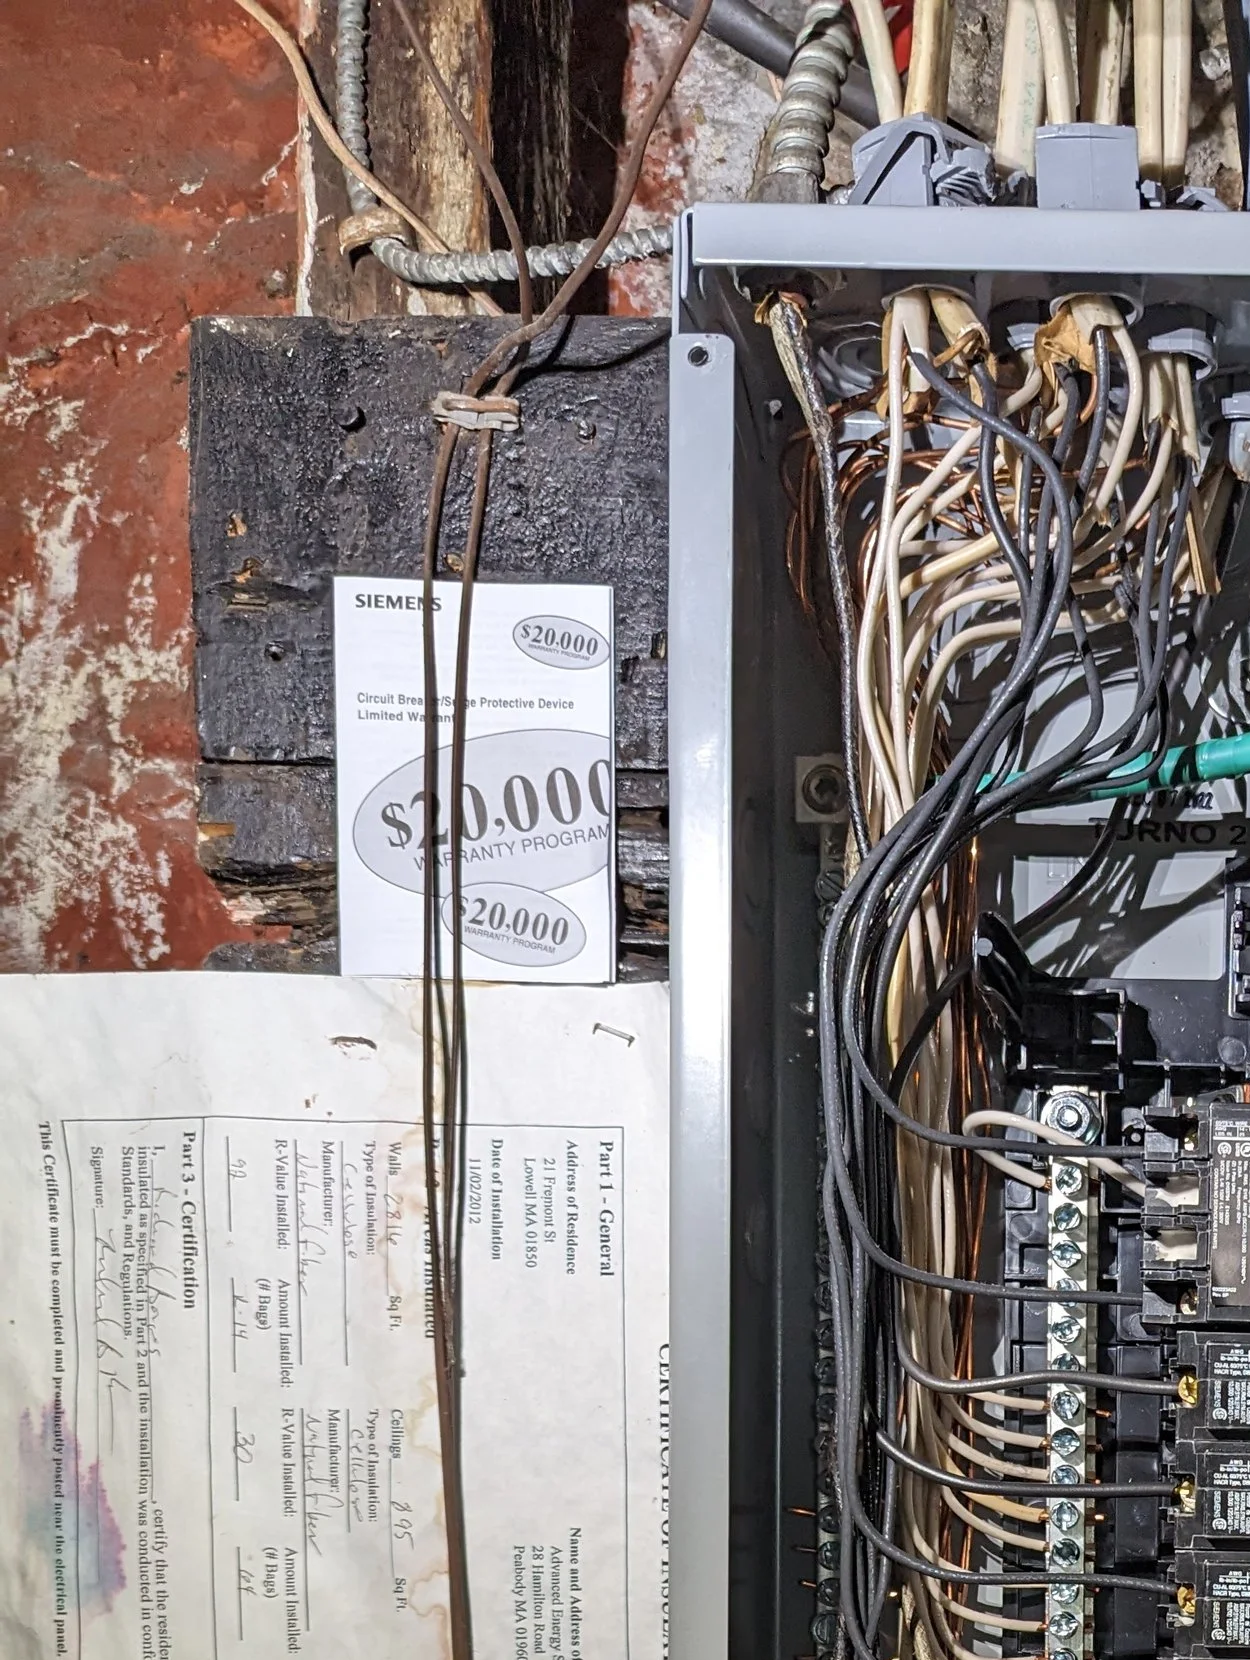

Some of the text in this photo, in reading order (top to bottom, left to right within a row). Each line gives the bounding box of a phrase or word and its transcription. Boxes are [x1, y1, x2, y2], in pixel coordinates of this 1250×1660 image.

[357, 692, 395, 705] Circuit
[480, 696, 535, 710] Protective
[538, 698, 574, 710] Device
[358, 710, 403, 722] Limited
[1229, 825, 1247, 846] 2
[464, 925, 557, 955] WARRANTY PROGRAM
[89, 1146, 105, 1210] Signature:
[322, 1140, 335, 1227] Manufacturer:
[388, 1142, 402, 1176] Walls
[275, 1139, 289, 1250] R-Value Installed:
[363, 1140, 377, 1256] Type of Insulation:
[468, 1157, 482, 1224] 11/02/2012
[491, 1138, 504, 1260] Date of Installation
[524, 1157, 538, 1268] Lowell MA 01850
[543, 1157, 556, 1243] 21 Fremont St
[566, 1140, 579, 1275] Address of Residence
[599, 1140, 615, 1277] Part 1 General
[119, 1146, 136, 1341] Standards, and Regulations.
[181, 1131, 198, 1310] Part 3 Certification
[134, 1231, 149, 1295] specified
[256, 1295, 272, 1331] Bags)
[387, 1296, 402, 1311] Sq
[389, 1315, 402, 1331] Ft.
[278, 1279, 292, 1388] Amount Installed:
[38, 1121, 68, 1657] This Certificate must completed prominently posted electrical panel.
[1213, 1380, 1222, 1408] SIEMENS
[232, 1430, 256, 1464] 30
[389, 1408, 405, 1459] Ceilings
[151, 1508, 169, 1554] certify
[569, 1526, 582, 1565] Name
[138, 1530, 153, 1603] conducted
[511, 1545, 526, 1597] Peabody
[551, 1545, 564, 1605] Advanced
[569, 1568, 583, 1592] and
[515, 1599, 527, 1623] MA
[532, 1545, 547, 1654] 28 Hamilton Road
[570, 1595, 583, 1647] Address
[549, 1609, 565, 1652] Energy
